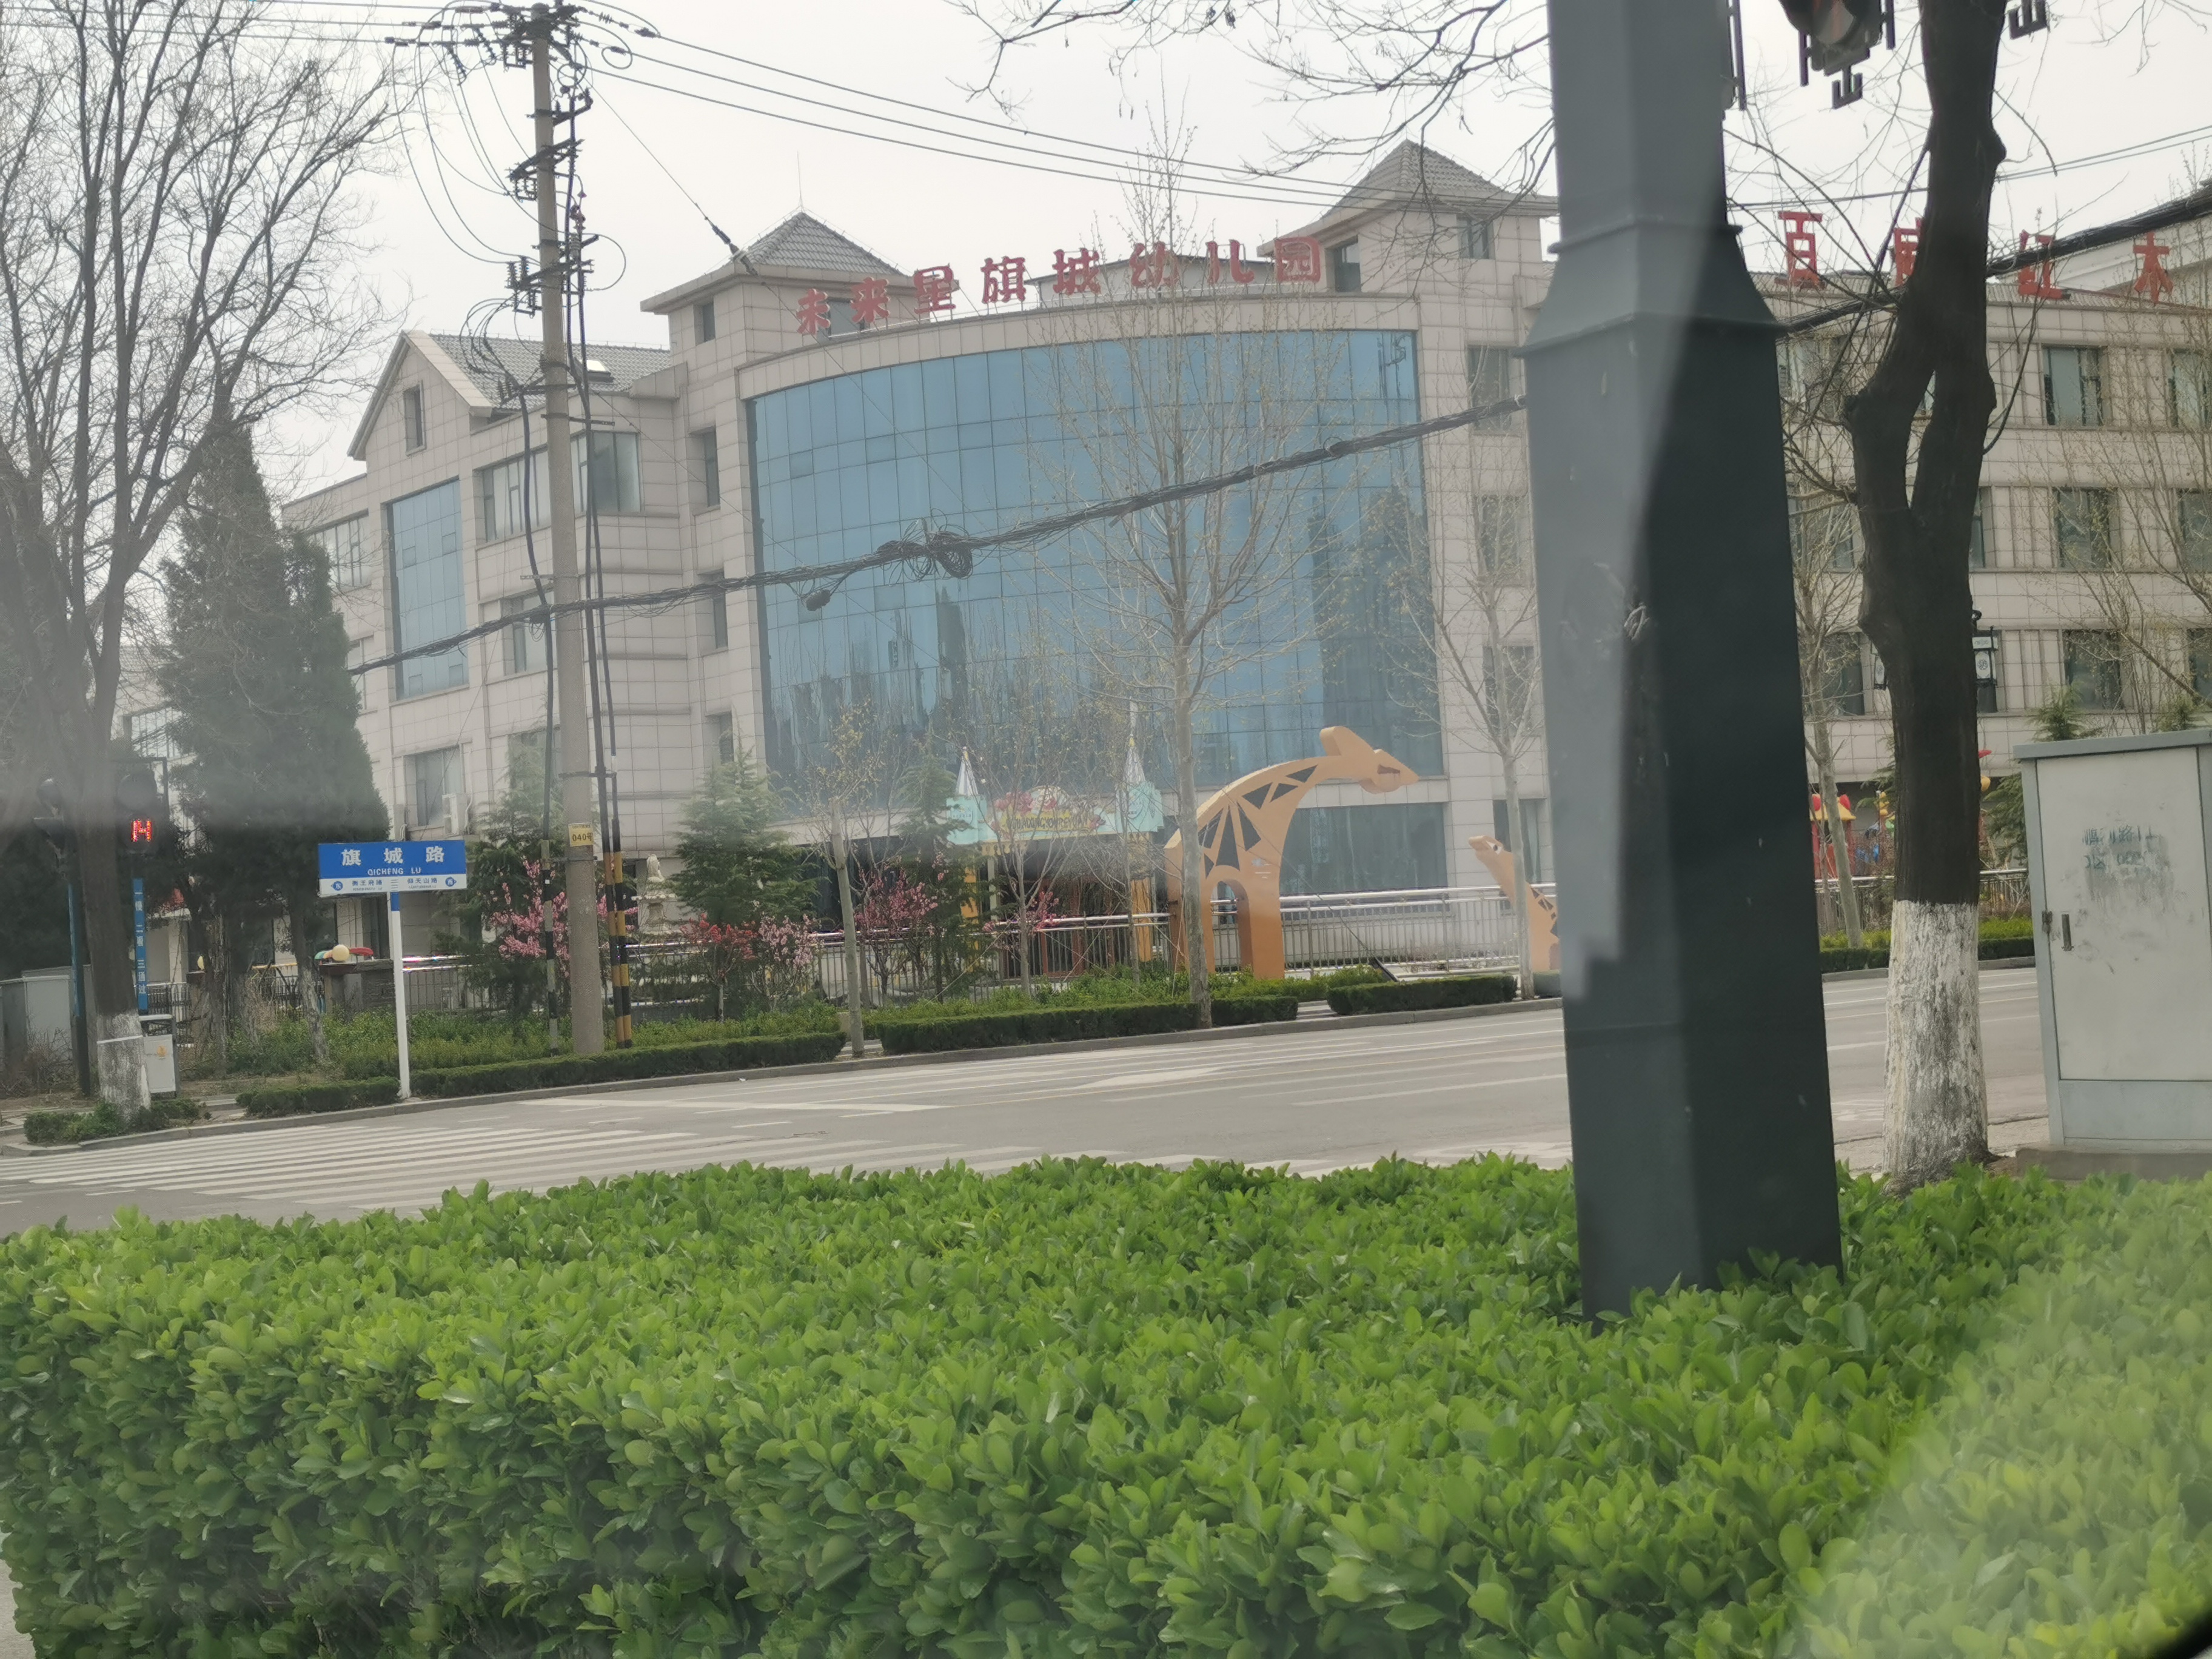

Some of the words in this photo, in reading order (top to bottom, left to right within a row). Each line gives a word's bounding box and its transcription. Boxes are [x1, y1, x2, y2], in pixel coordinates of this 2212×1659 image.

[796, 235, 1321, 334] 未来星旗城幼儿园
[572, 833, 592, 841] 040号
[341, 846, 444, 866] 旗城路
